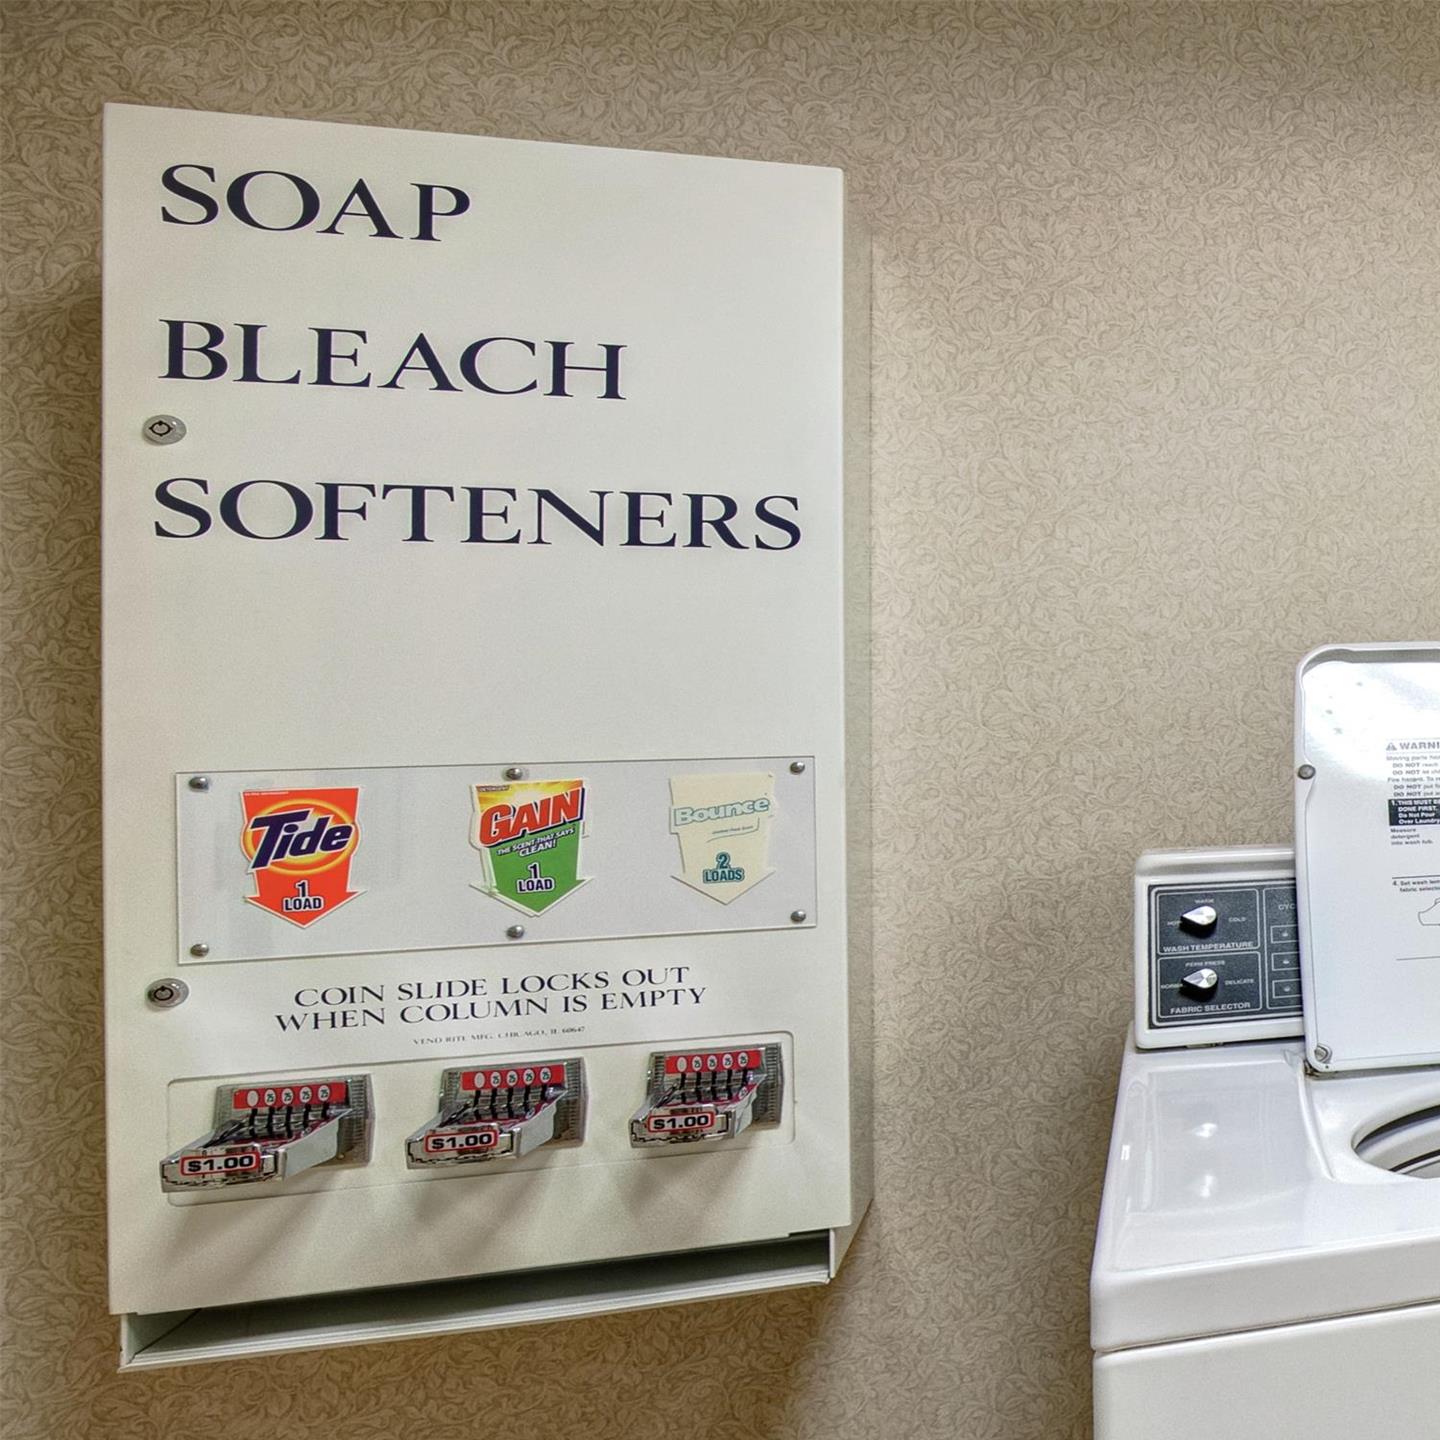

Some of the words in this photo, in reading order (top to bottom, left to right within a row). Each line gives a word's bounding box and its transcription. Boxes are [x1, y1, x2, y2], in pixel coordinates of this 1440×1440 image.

[160, 164, 471, 241] SOAP
[157, 319, 628, 400] BLEACH
[153, 477, 801, 551] SOFTENERS
[480, 787, 585, 848] GAIN
[674, 798, 770, 826] Bounce
[248, 808, 354, 871] Tide
[498, 847, 511, 855] THE
[513, 840, 536, 850] SCENT
[556, 828, 574, 838] SAYS
[520, 839, 556, 857] CLEAN!
[716, 852, 730, 869] 2
[528, 863, 540, 879] 1
[703, 868, 744, 883] LOADS
[296, 881, 309, 898] 1
[518, 879, 553, 892] LOAD
[284, 897, 324, 911] LOAD
[1190, 941, 1253, 951] TEMPERATURE
[295, 985, 384, 1008] COIN
[398, 979, 487, 1001] SLIDE
[502, 971, 610, 995] LOCKS
[622, 966, 690, 986] OUT
[274, 1009, 385, 1032] WHEN
[399, 997, 548, 1023] COLUMN
[563, 994, 588, 1013] IS
[600, 987, 706, 1010] EMPTY
[1170, 1006, 1202, 1014] FABRIC
[1204, 1002, 1250, 1012] SELECTOR
[654, 1115, 709, 1129] $1.00
[432, 1134, 492, 1149] $1.00
[188, 1156, 253, 1172] $1.00
